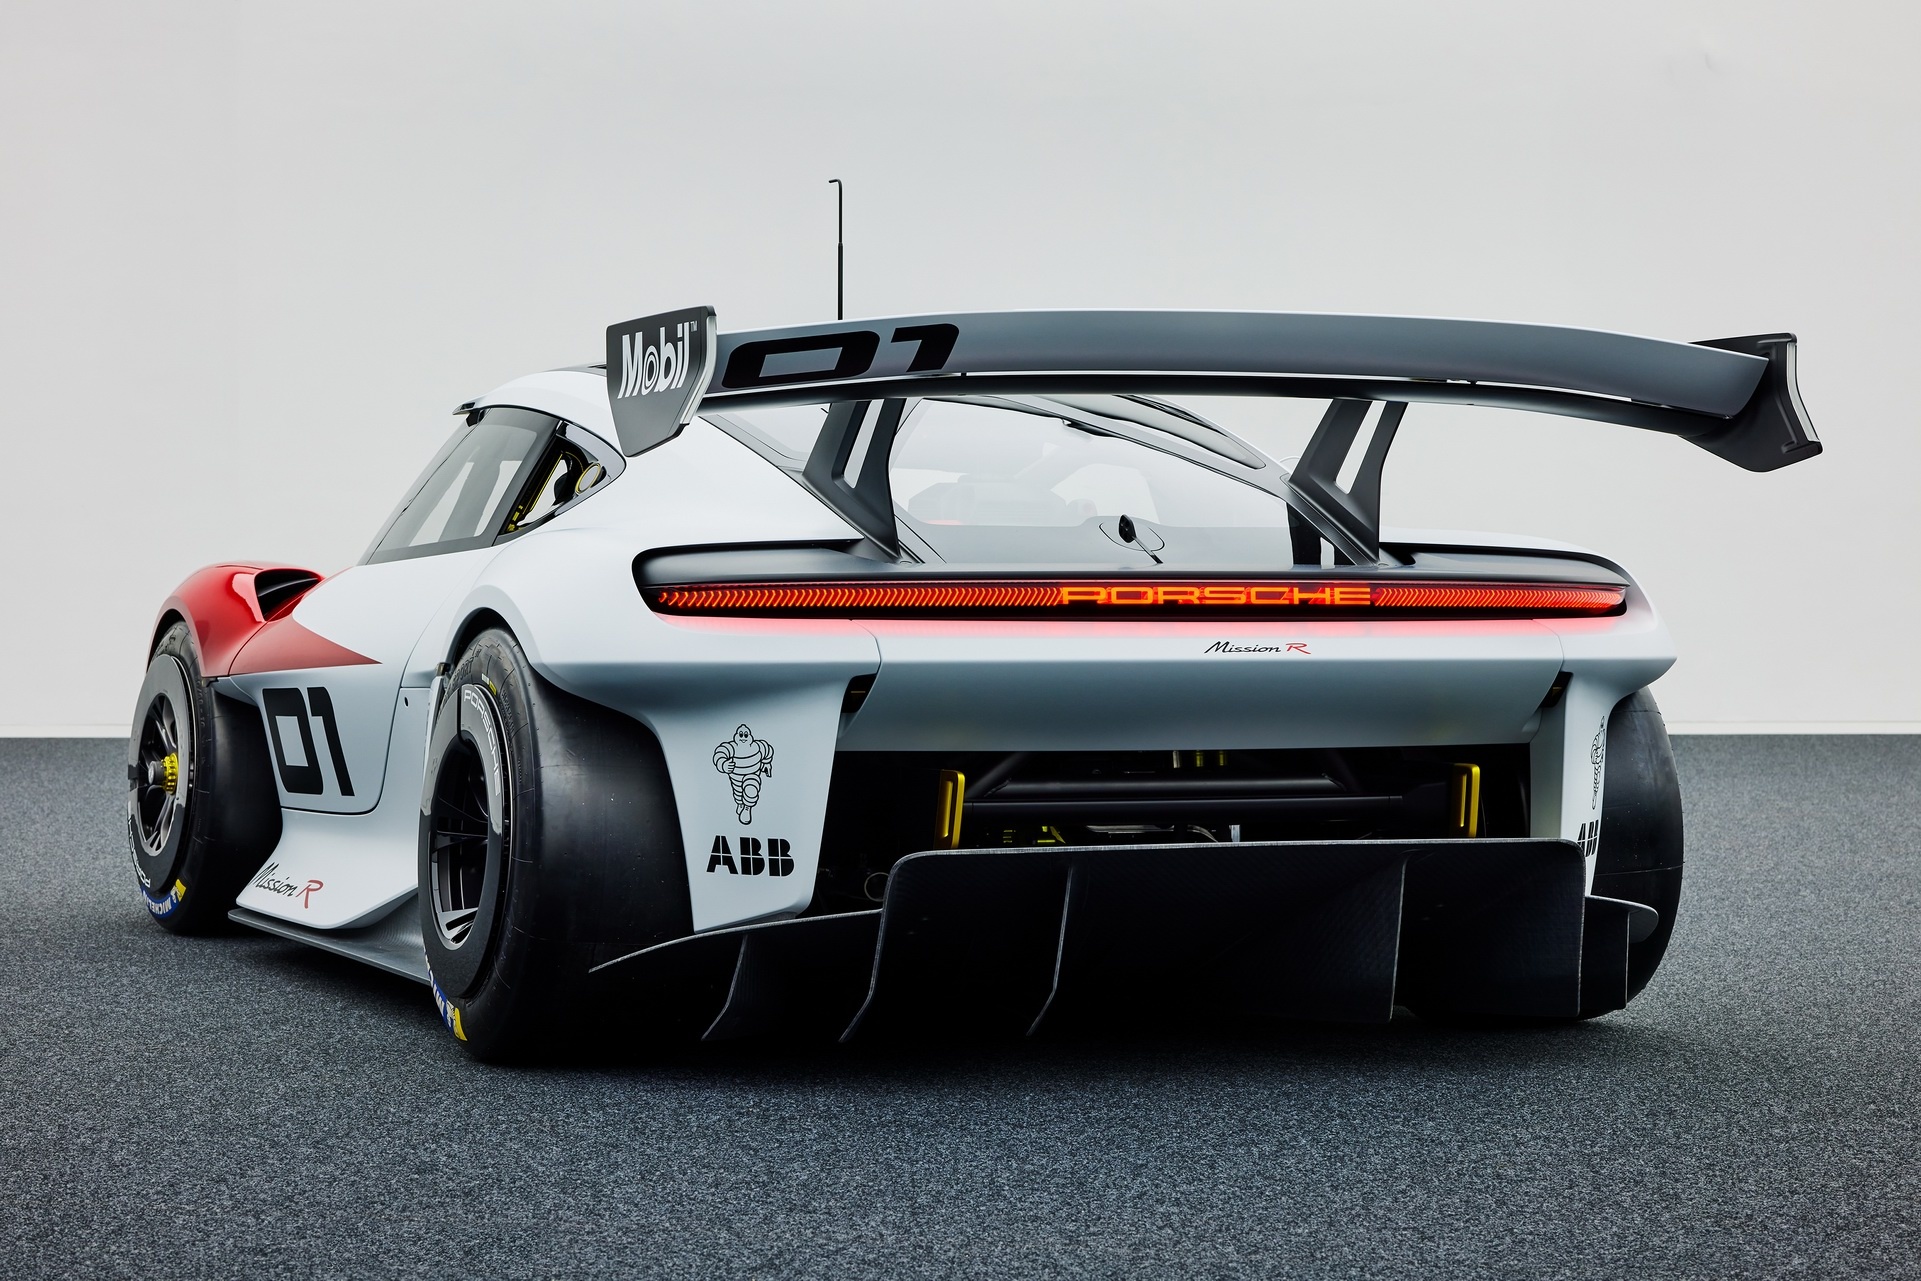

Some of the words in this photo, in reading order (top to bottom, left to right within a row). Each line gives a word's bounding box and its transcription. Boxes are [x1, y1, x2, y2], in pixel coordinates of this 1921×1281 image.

[617, 321, 690, 399] Mobil
[721, 323, 960, 389] 01
[1061, 586, 1371, 605] PORSCHE
[1204, 640, 1282, 654] Mission
[1285, 642, 1312, 655] R
[262, 686, 355, 797] 01
[463, 689, 501, 796] PORSCHE
[706, 835, 795, 877] ABB
[250, 862, 299, 897] Mission
[296, 879, 324, 909] R
